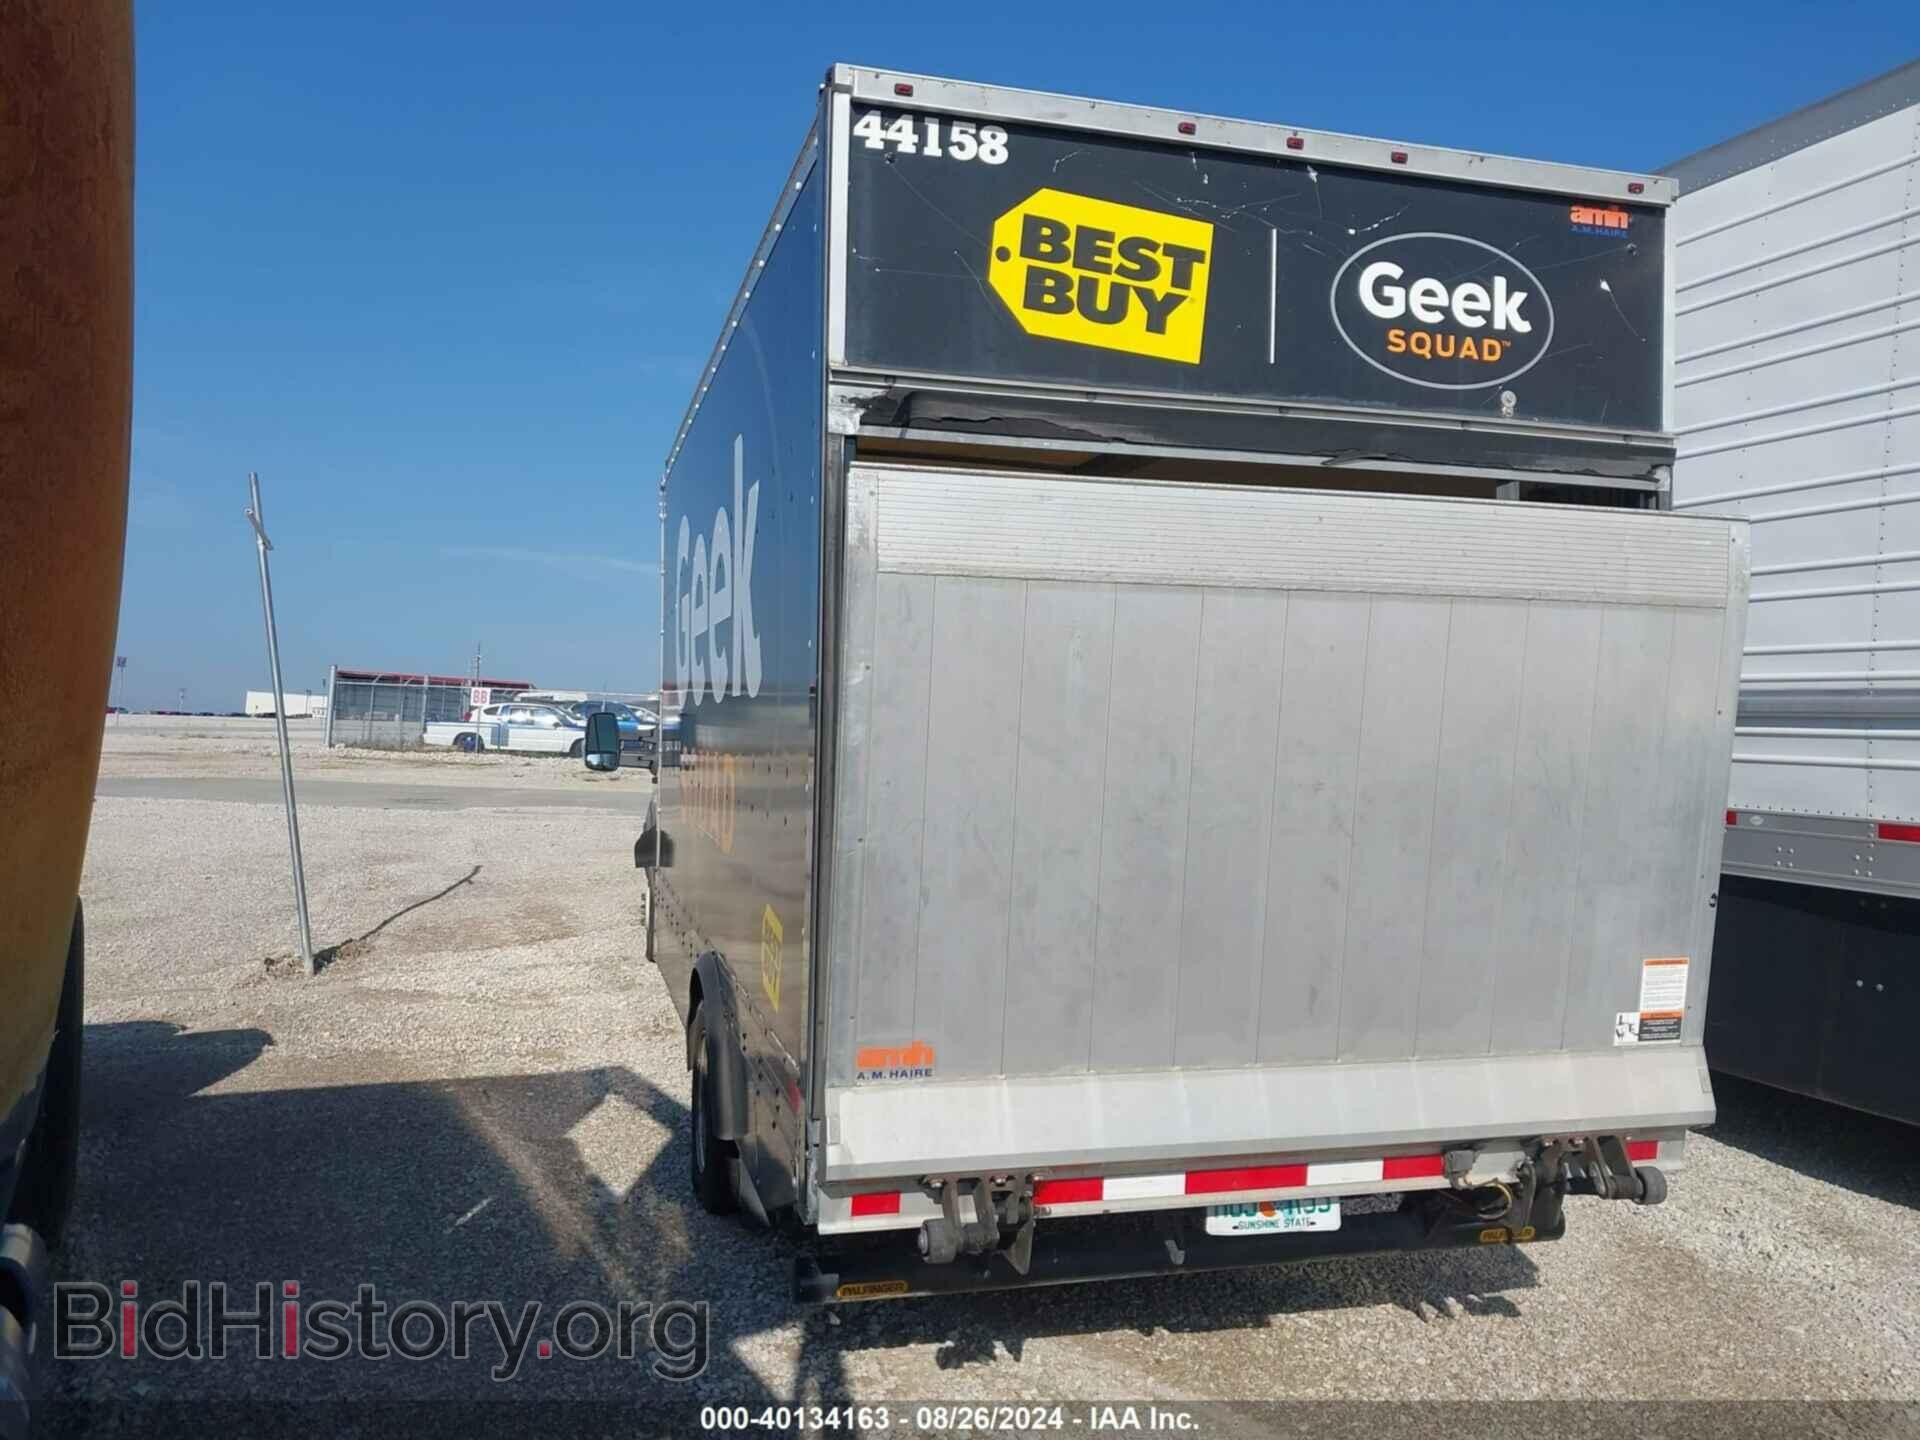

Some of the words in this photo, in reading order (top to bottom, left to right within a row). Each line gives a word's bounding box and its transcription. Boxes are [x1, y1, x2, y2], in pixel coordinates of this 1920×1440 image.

[853, 110, 1009, 165] 44158
[1019, 213, 1206, 291] BEST
[1022, 264, 1189, 335] BUY
[1358, 261, 1532, 333] Geek
[1386, 328, 1501, 362] SQUAD
[676, 434, 762, 716] Geek
[889, 1068, 934, 1079] HAIRE
[1238, 1219, 1279, 1231] SUNSHINE
